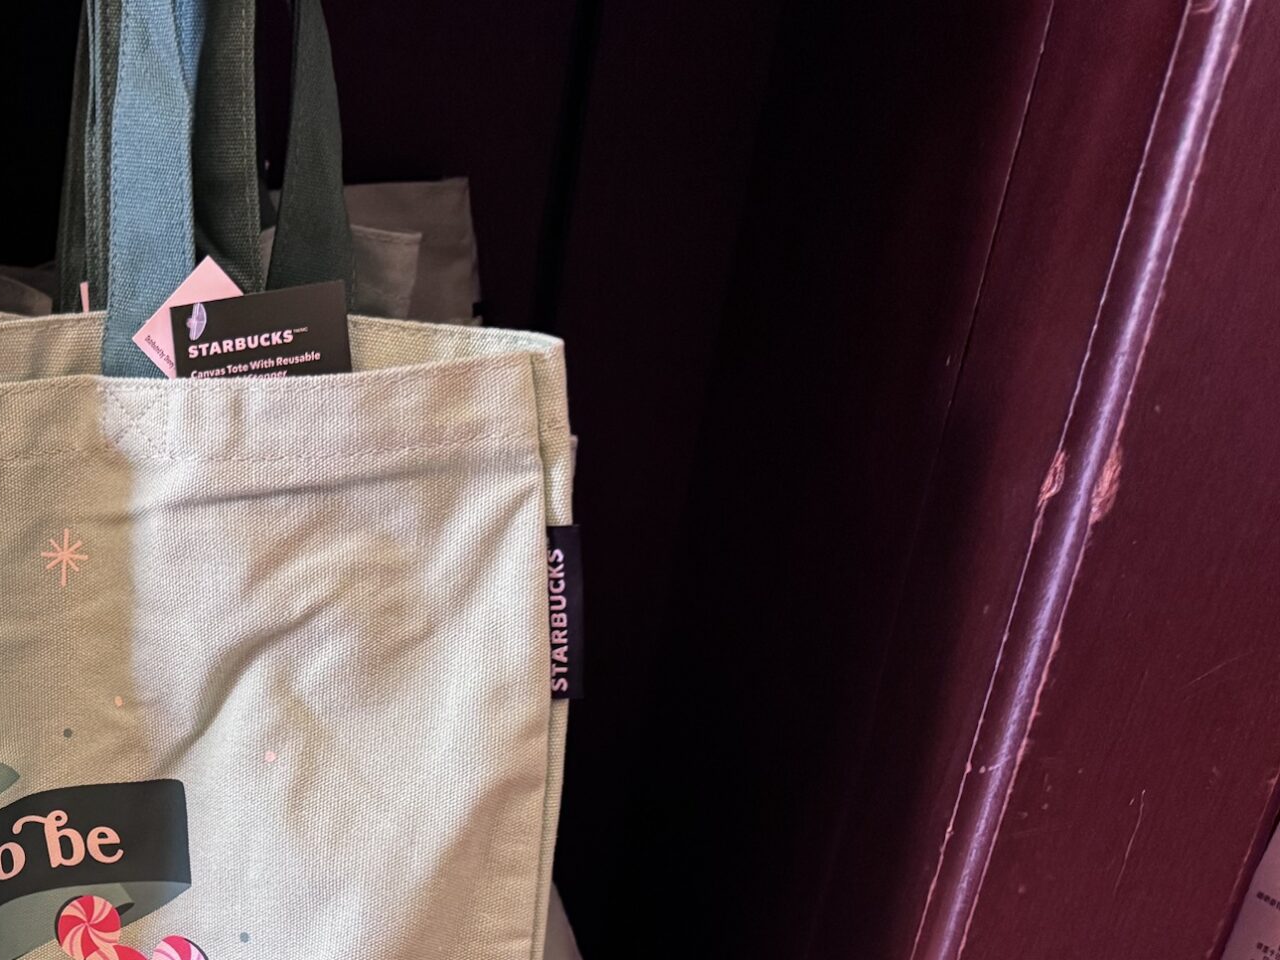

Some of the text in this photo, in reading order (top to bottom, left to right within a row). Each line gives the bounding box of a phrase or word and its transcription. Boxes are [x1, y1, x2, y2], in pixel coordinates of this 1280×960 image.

[188, 329, 294, 358] STARBUCKS
[191, 366, 226, 379] Canvas
[226, 362, 249, 374] Tote
[249, 358, 275, 370] With
[276, 350, 321, 366] Reusable
[548, 548, 568, 692] STARBUCKS
[12, 810, 124, 869] be
